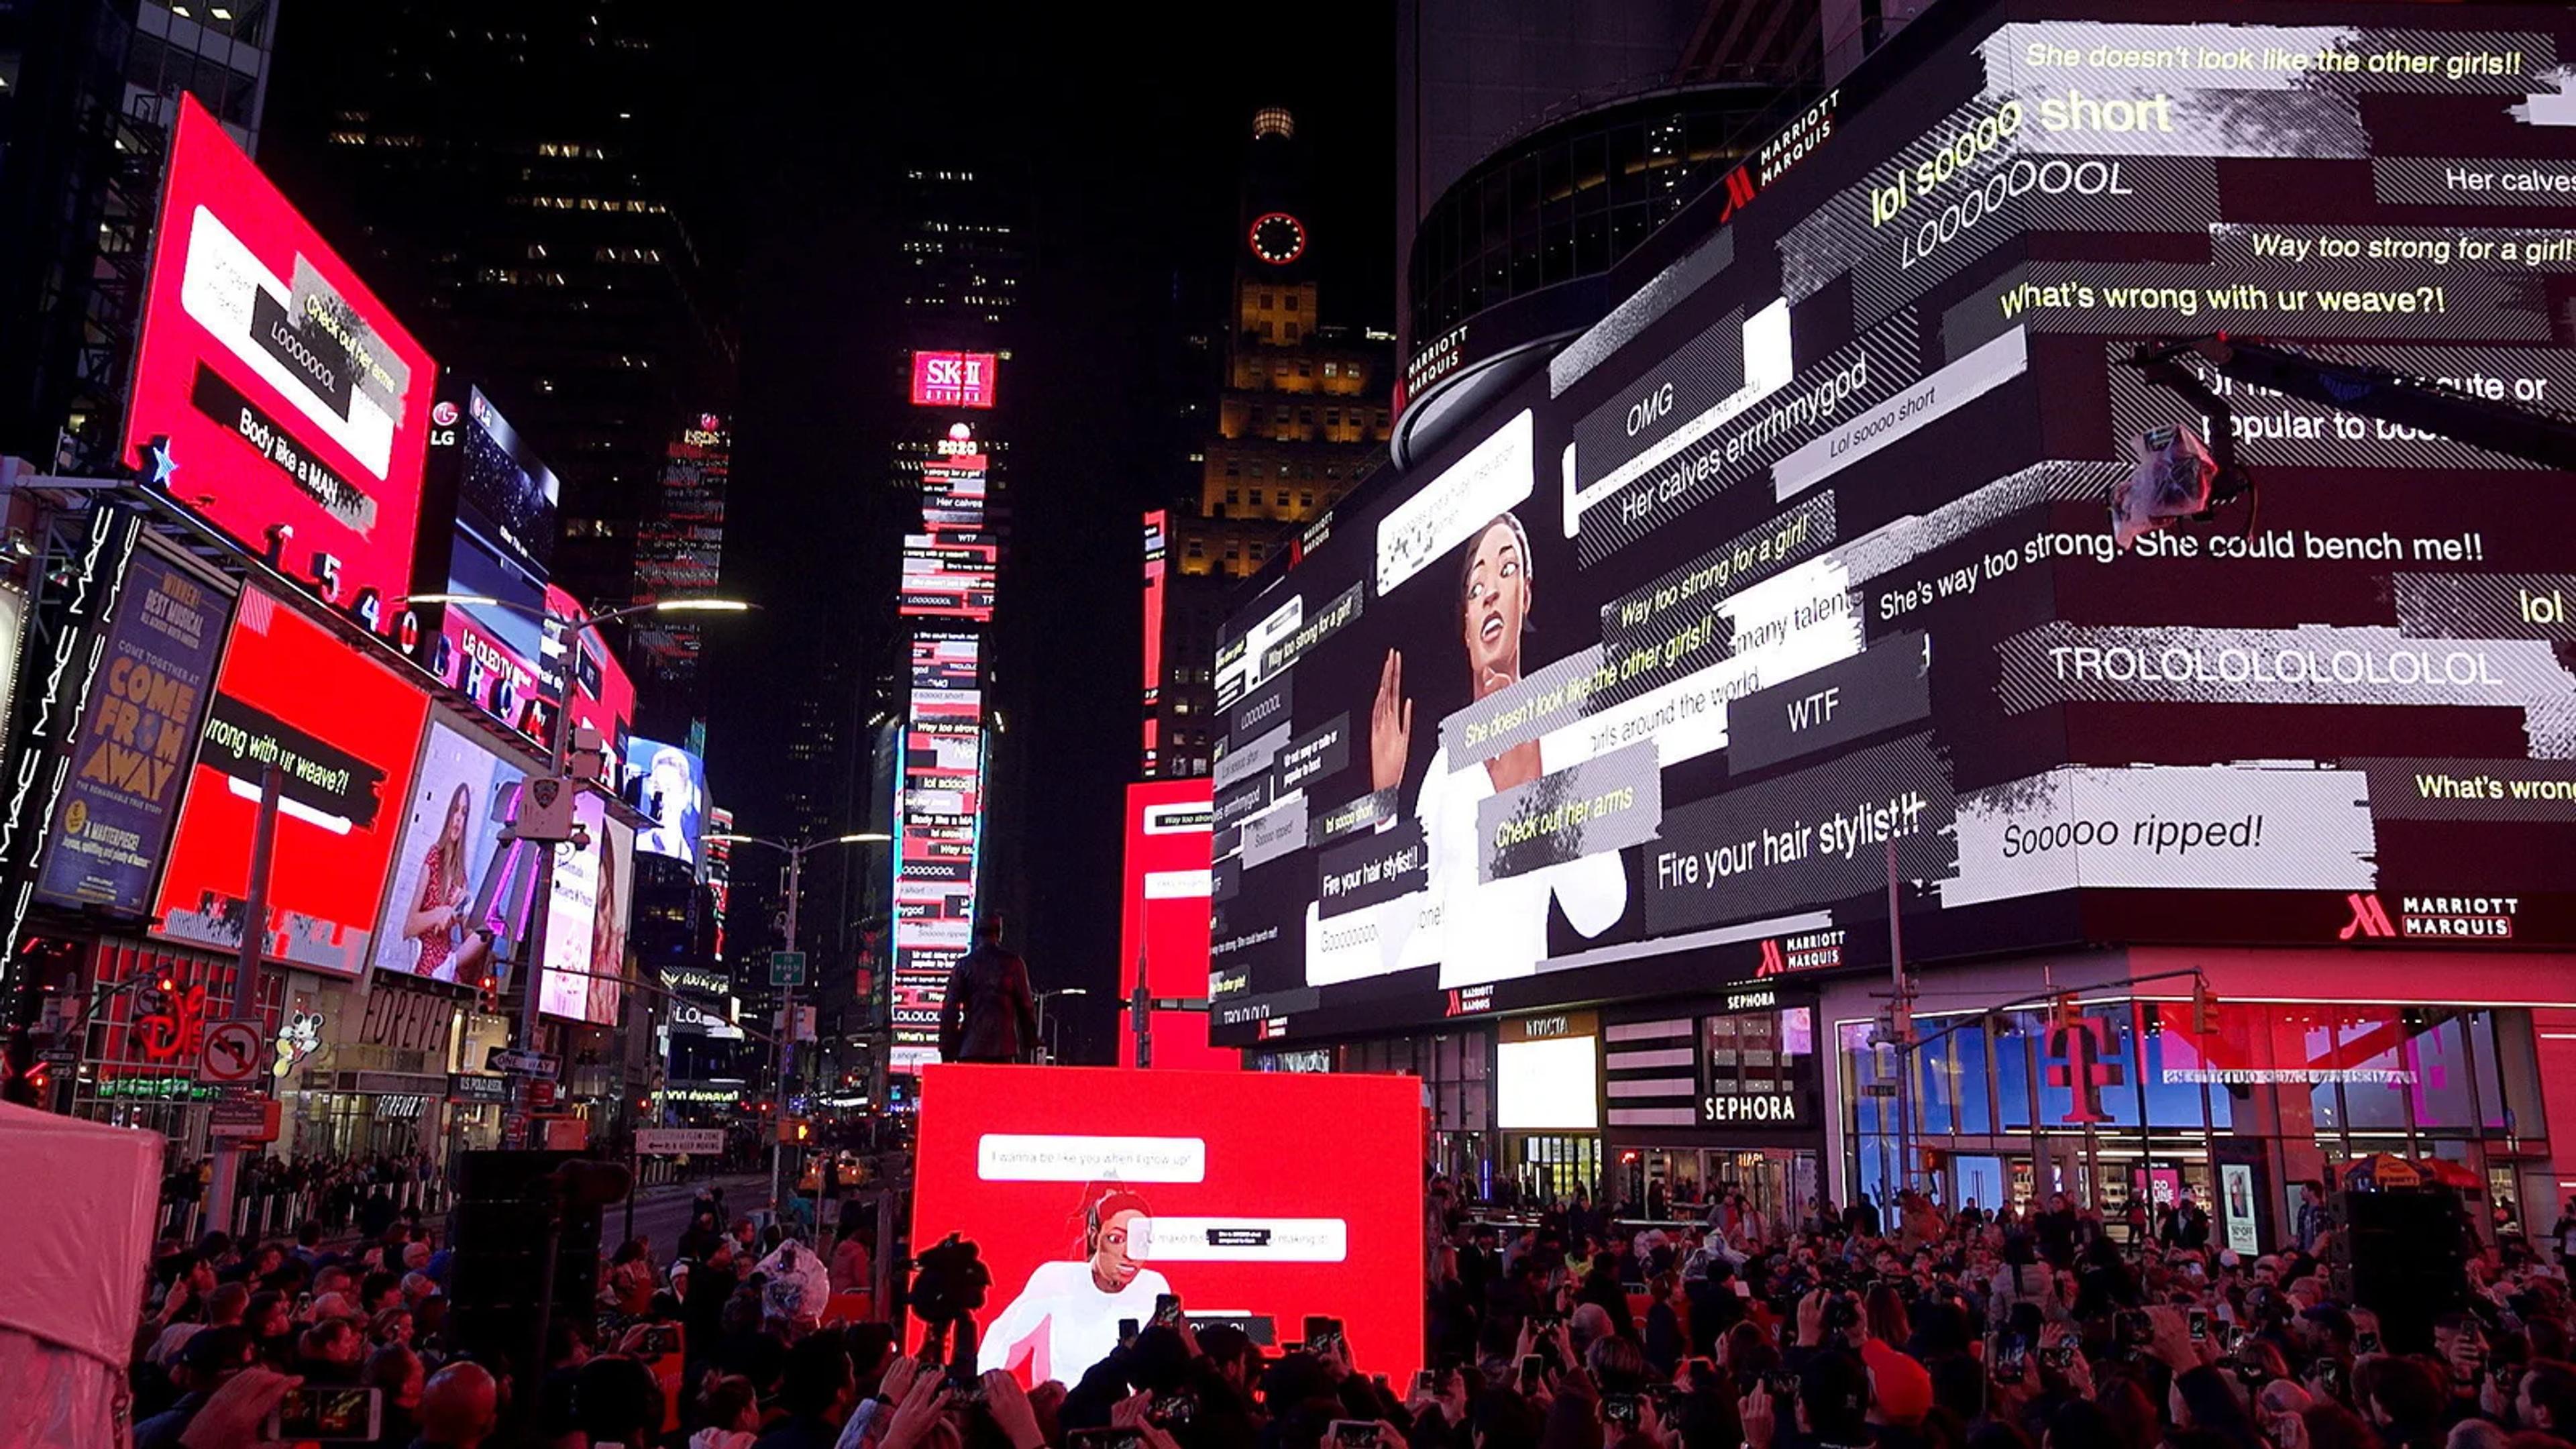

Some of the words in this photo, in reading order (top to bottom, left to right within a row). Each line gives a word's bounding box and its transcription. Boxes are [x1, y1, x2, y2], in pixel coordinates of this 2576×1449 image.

[2027, 42, 2084, 68] She
[2089, 44, 2192, 69] doesn't
[2198, 46, 2253, 70] look
[2263, 46, 2308, 70] like
[2317, 49, 2359, 72] the
[2368, 50, 2440, 74] other
[2447, 51, 2521, 79] girls!!
[1760, 89, 1840, 166] MARRIOTT
[1761, 120, 1831, 186] MARQUIS
[1870, 170, 1907, 227] lol
[1915, 101, 2021, 195] soooo
[2041, 89, 2173, 133] short
[2446, 167, 2494, 191] Her
[2253, 233, 2310, 260] Way
[2320, 235, 2358, 260] too
[2367, 235, 2450, 265] strong
[2459, 237, 2494, 260] for
[2500, 242, 2517, 260] a
[2000, 280, 2094, 319] What's
[2104, 288, 2198, 316] wrong
[2206, 287, 2269, 311] with
[2278, 289, 2308, 311] ur
[2316, 284, 2445, 313] weave?!
[307, 294, 341, 339] Check
[339, 330, 356, 355] out
[355, 339, 372, 369] her
[372, 360, 396, 393] arms
[1408, 325, 1468, 377] MARRIOTT
[1408, 350, 1459, 398] MARQUIS
[2515, 377, 2547, 400] or
[1627, 382, 1673, 437] OMG
[1830, 432, 1851, 459] Lol
[1853, 411, 1896, 446] soooo
[1898, 386, 1936, 421] short
[2335, 411, 2365, 440] to
[239, 407, 274, 458] Body
[275, 437, 297, 474] like
[298, 462, 308, 482] a
[309, 463, 338, 504] MAN
[431, 430, 455, 445] LG
[1621, 490, 1654, 525] Her
[1660, 450, 1721, 506] calves
[1726, 350, 1868, 464] errrrhmygod
[1621, 600, 1651, 629] Way
[1655, 584, 1679, 610] too
[1681, 562, 1729, 600] strong
[1733, 545, 1756, 576] for
[1760, 541, 1770, 561] a
[1775, 513, 1809, 559] girl!
[1880, 581, 1933, 620] She's
[1938, 565, 1979, 600] way
[1984, 547, 2018, 580] too
[2025, 531, 2123, 564] strong.
[2304, 532, 2402, 561] bench
[2414, 534, 2482, 562] me!!
[2520, 590, 2563, 624] lol
[463, 629, 476, 657] LG
[1736, 616, 1787, 651] many
[119, 640, 144, 661] COME
[146, 652, 189, 682] TOGETHER
[189, 674, 200, 685] AT
[1464, 722, 1489, 748] She
[1491, 698, 1534, 738] doesn't
[1538, 686, 1564, 718] look
[1567, 674, 1592, 704] like
[1595, 663, 1617, 690] the
[1621, 643, 1663, 682] other
[1665, 615, 1713, 667] girls!!
[2048, 646, 2503, 686] TROLOLOLOLOLOLOL
[109, 655, 197, 720] COME
[1621, 700, 1675, 739] around
[1680, 693, 1707, 721] the
[1711, 667, 1765, 704] world.
[94, 694, 186, 767] FROM
[917, 723, 938, 734] Way
[1787, 688, 1839, 733] WTF
[80, 739, 176, 802] AWAY
[250, 735, 278, 765] with
[279, 750, 293, 773] ur
[297, 756, 350, 797] weave?!
[2416, 774, 2504, 799] What's
[2510, 780, 2576, 804] wron
[1165, 816, 1181, 826] Way
[1497, 817, 1539, 849] Check
[1540, 806, 1564, 834] out
[1567, 800, 1591, 826] her
[1595, 786, 1633, 816] arms
[2003, 820, 2120, 858] Sooooo
[2133, 814, 2263, 855] ripped!
[1658, 852, 1699, 890] Fire
[1706, 837, 1756, 889] your
[1763, 821, 1812, 867] hair
[1323, 874, 1341, 898] Fire
[1341, 867, 1363, 898] your
[1363, 859, 1383, 885] hair
[2404, 897, 2518, 915] MARRIOTT
[2405, 917, 2510, 935] MARQUIS
[1787, 930, 1845, 951] MARRIOTT
[1788, 949, 1839, 969] MARQUIS
[1727, 991, 1775, 1010] SEPHORA
[1526, 1016, 1570, 1037] INVICTA
[498, 1055, 517, 1067] ONE
[527, 1059, 552, 1071] WAY
[377, 1094, 420, 1118] FOREVER
[1705, 1096, 1795, 1121] SEPHORA
